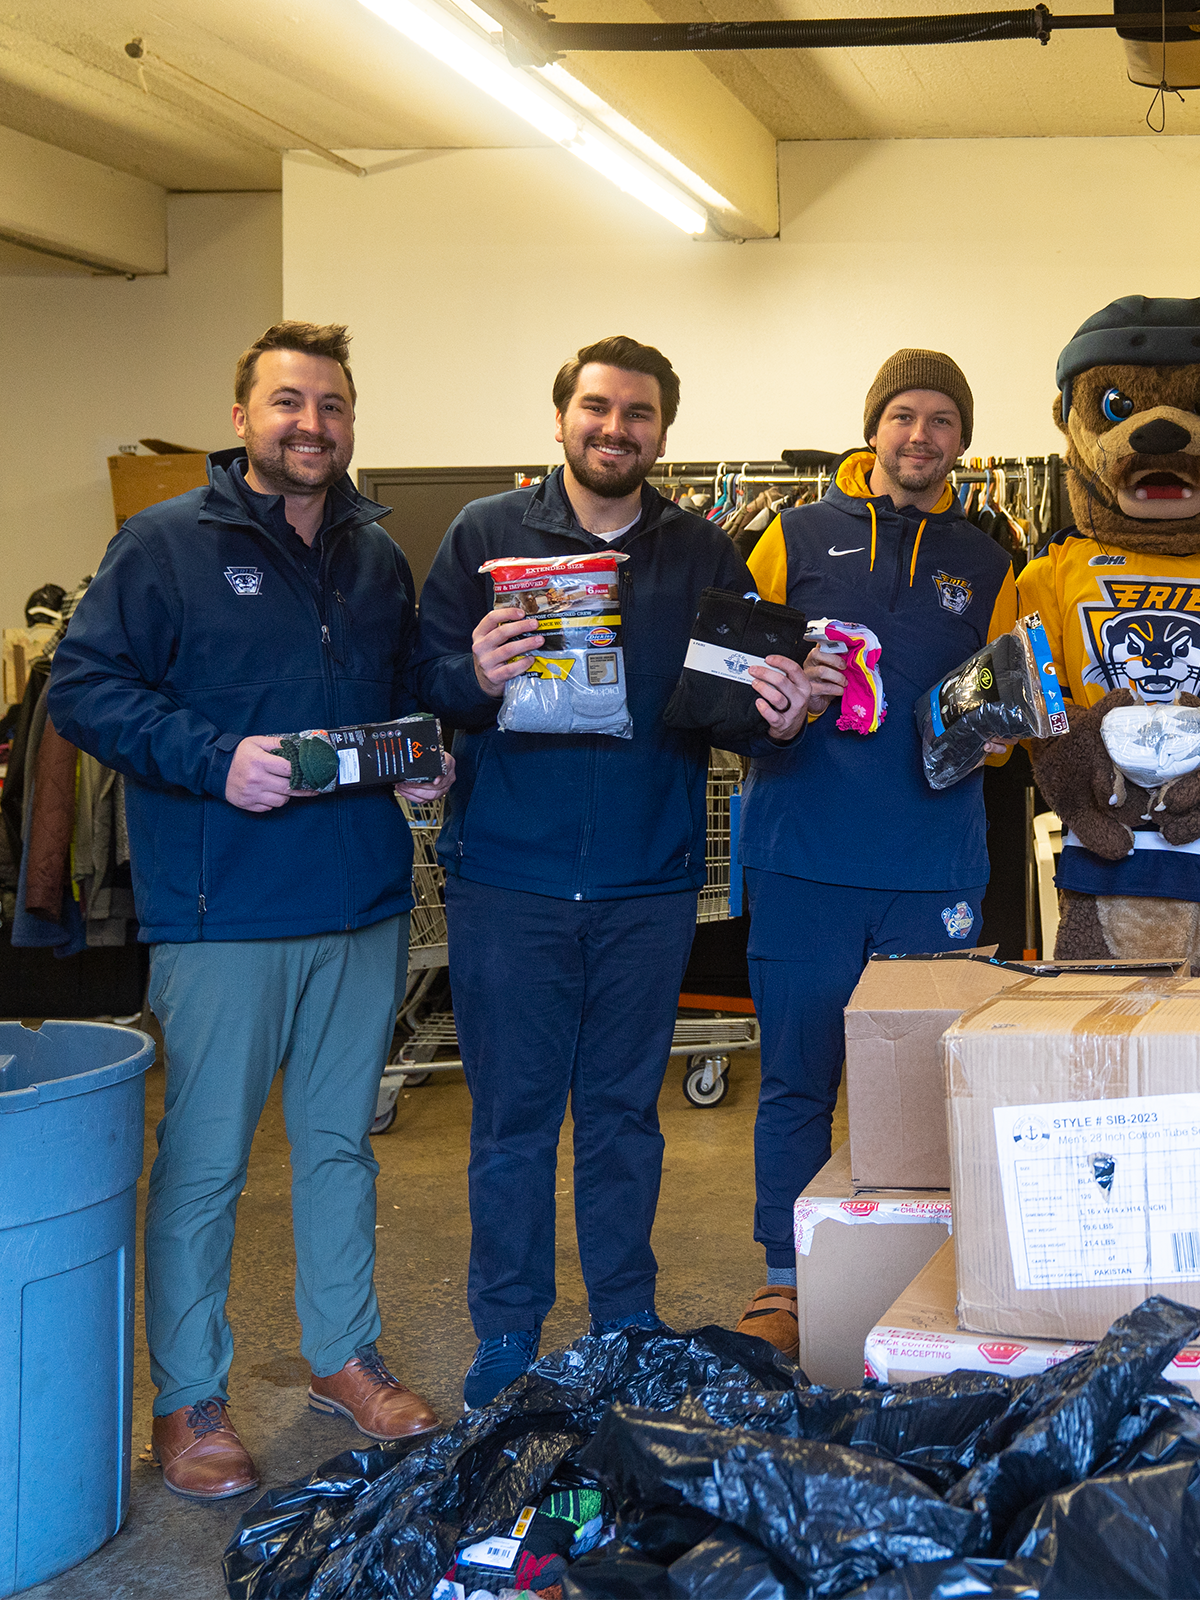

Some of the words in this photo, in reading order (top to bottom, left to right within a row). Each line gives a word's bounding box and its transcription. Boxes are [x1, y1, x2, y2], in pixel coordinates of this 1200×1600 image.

[525, 564, 566, 575] EXTENDED
[508, 580, 544, 590] IMPROVED
[587, 587, 594, 595] 6
[728, 653, 748, 665] DOCKERS
[1051, 714, 1063, 732] 6-12
[1053, 1116, 1093, 1129] STYLE
[1095, 1116, 1102, 1126] #
[1106, 1112, 1158, 1125] SIB-2023
[1058, 1134, 1088, 1145] Men's
[1090, 1132, 1103, 1142] 28
[1104, 1131, 1126, 1142] Inch
[1127, 1129, 1161, 1141] Cotton
[1162, 1127, 1189, 1138] Tube
[845, 1201, 876, 1210] STOP
[1143, 1204, 1167, 1213] (NCH)
[1094, 1268, 1132, 1276] PAKISTAN
[900, 1349, 952, 1360] ACCEPTING
